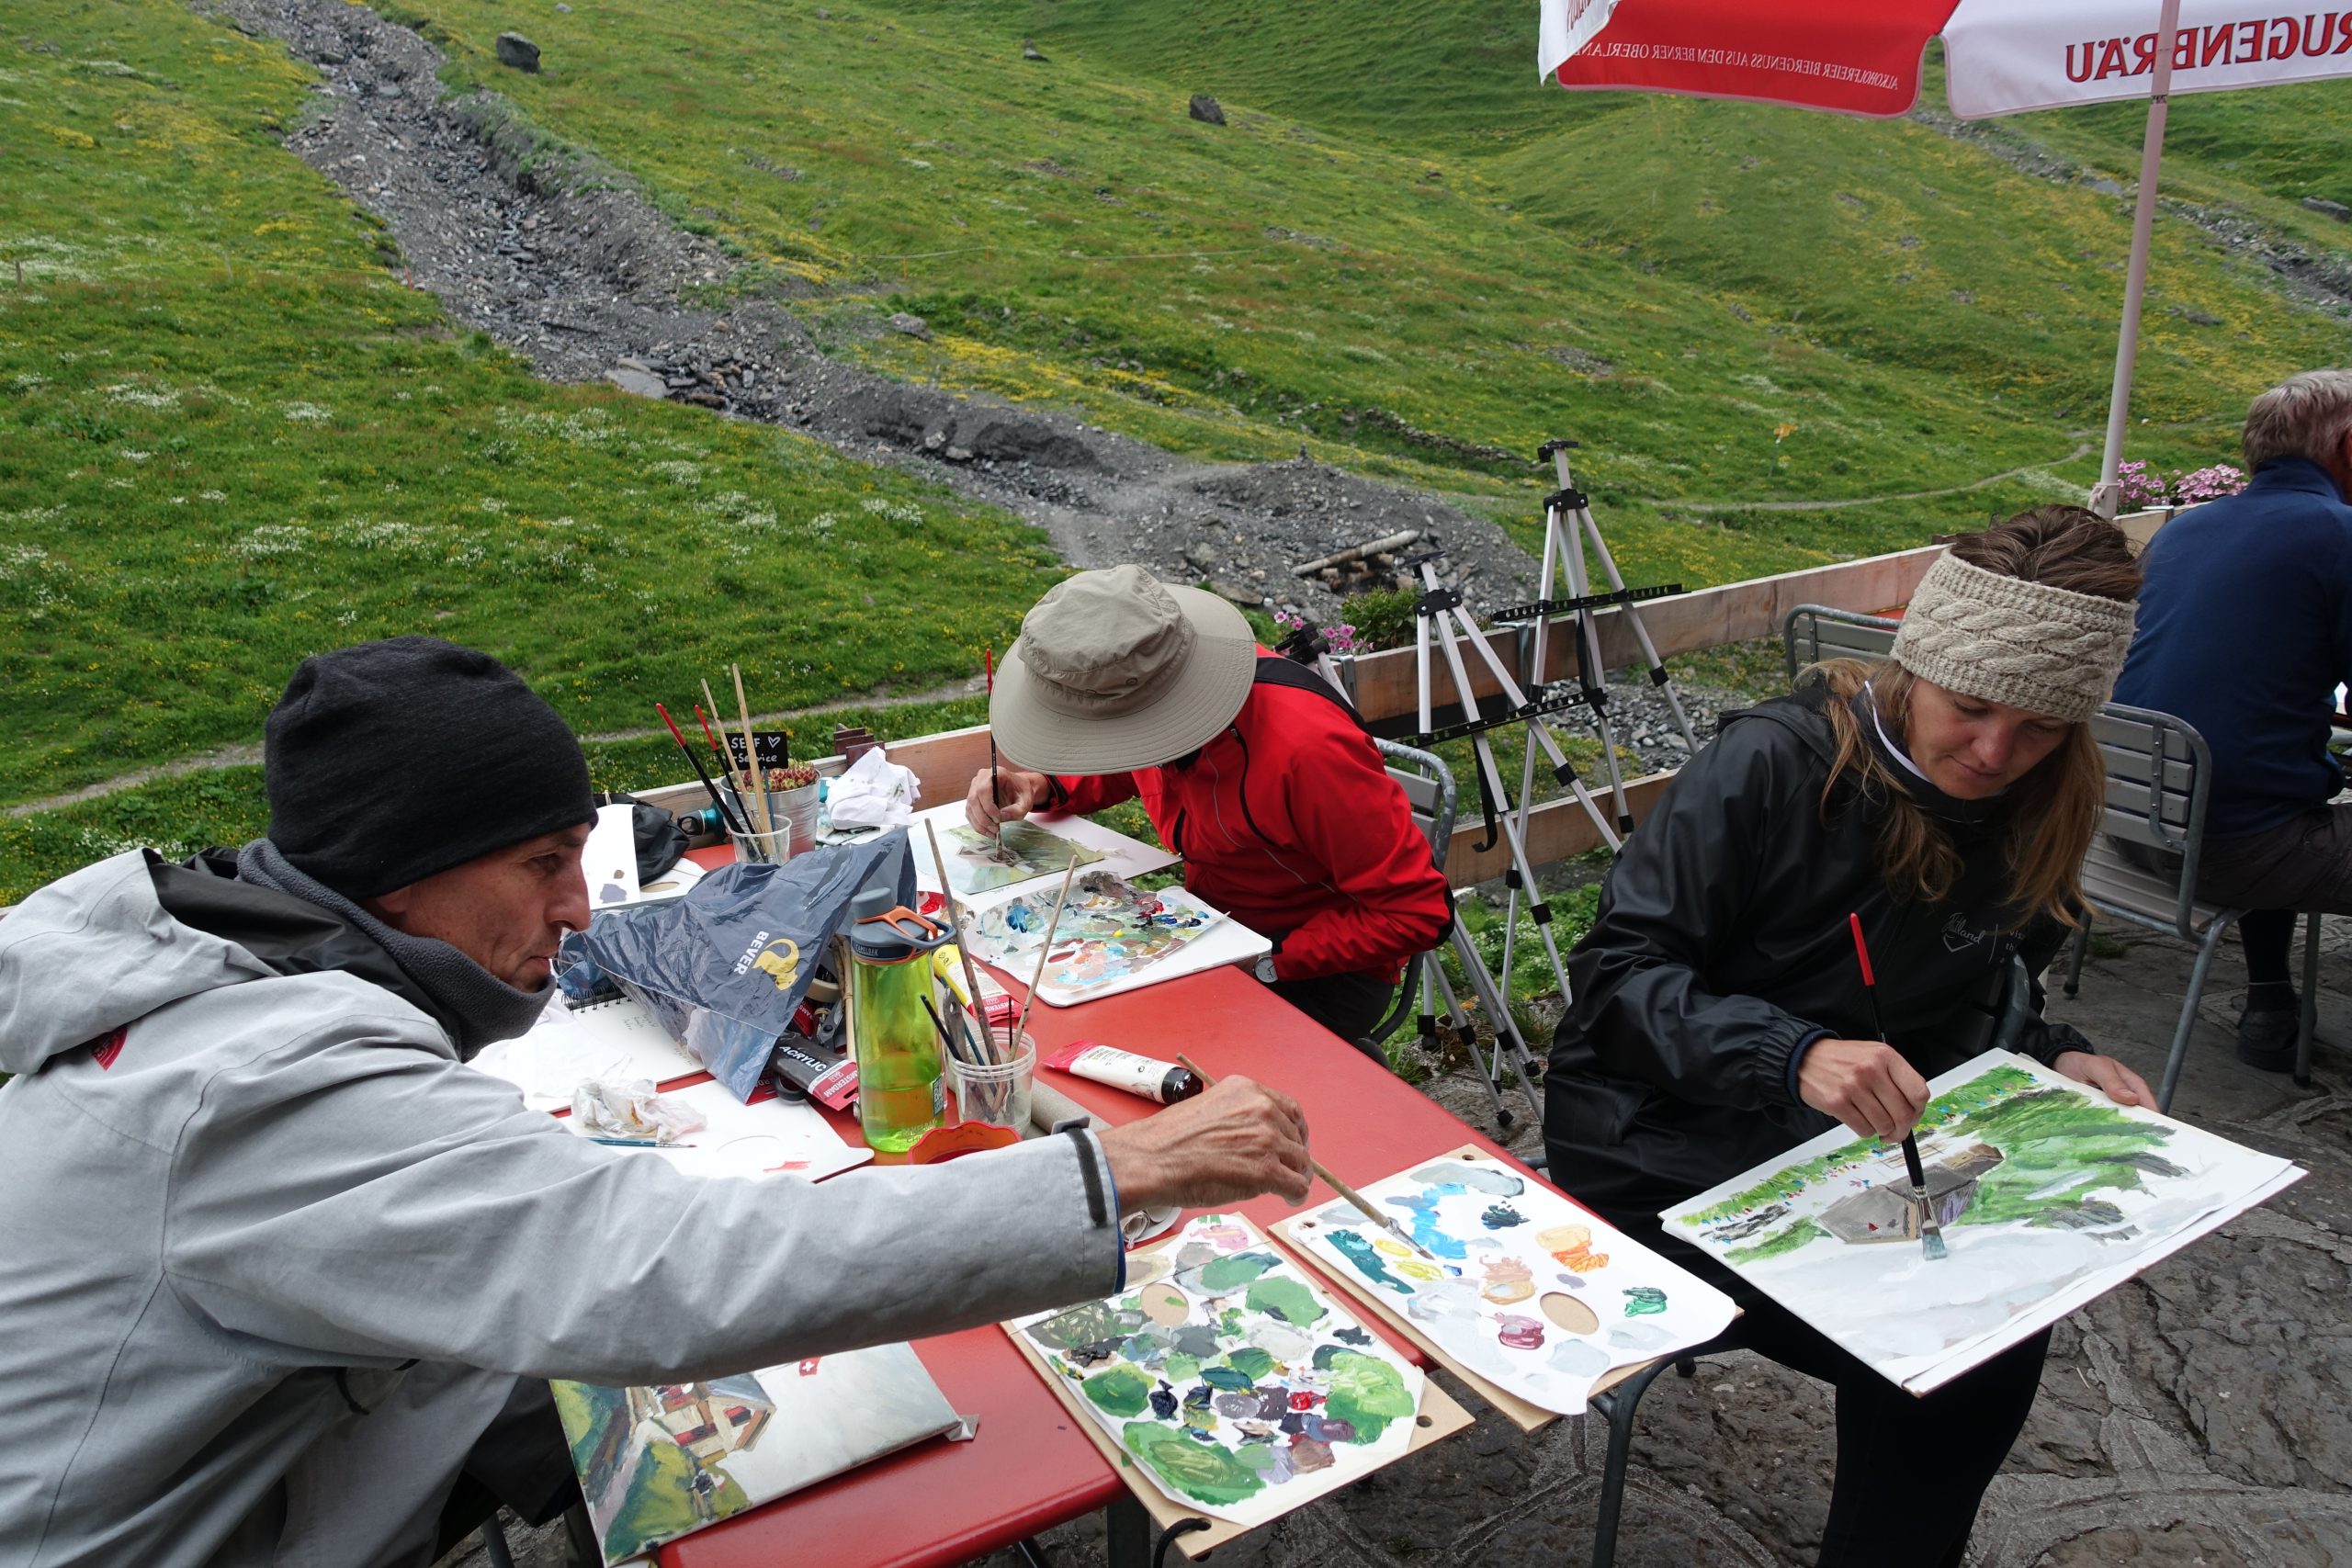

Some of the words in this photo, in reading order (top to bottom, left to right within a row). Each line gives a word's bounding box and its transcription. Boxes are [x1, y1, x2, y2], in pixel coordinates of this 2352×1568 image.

[731, 737, 761, 749] SEF
[734, 753, 778, 763] -Sevice
[734, 931, 769, 975] BEVER
[779, 1045, 827, 1072] ACRYLIC
